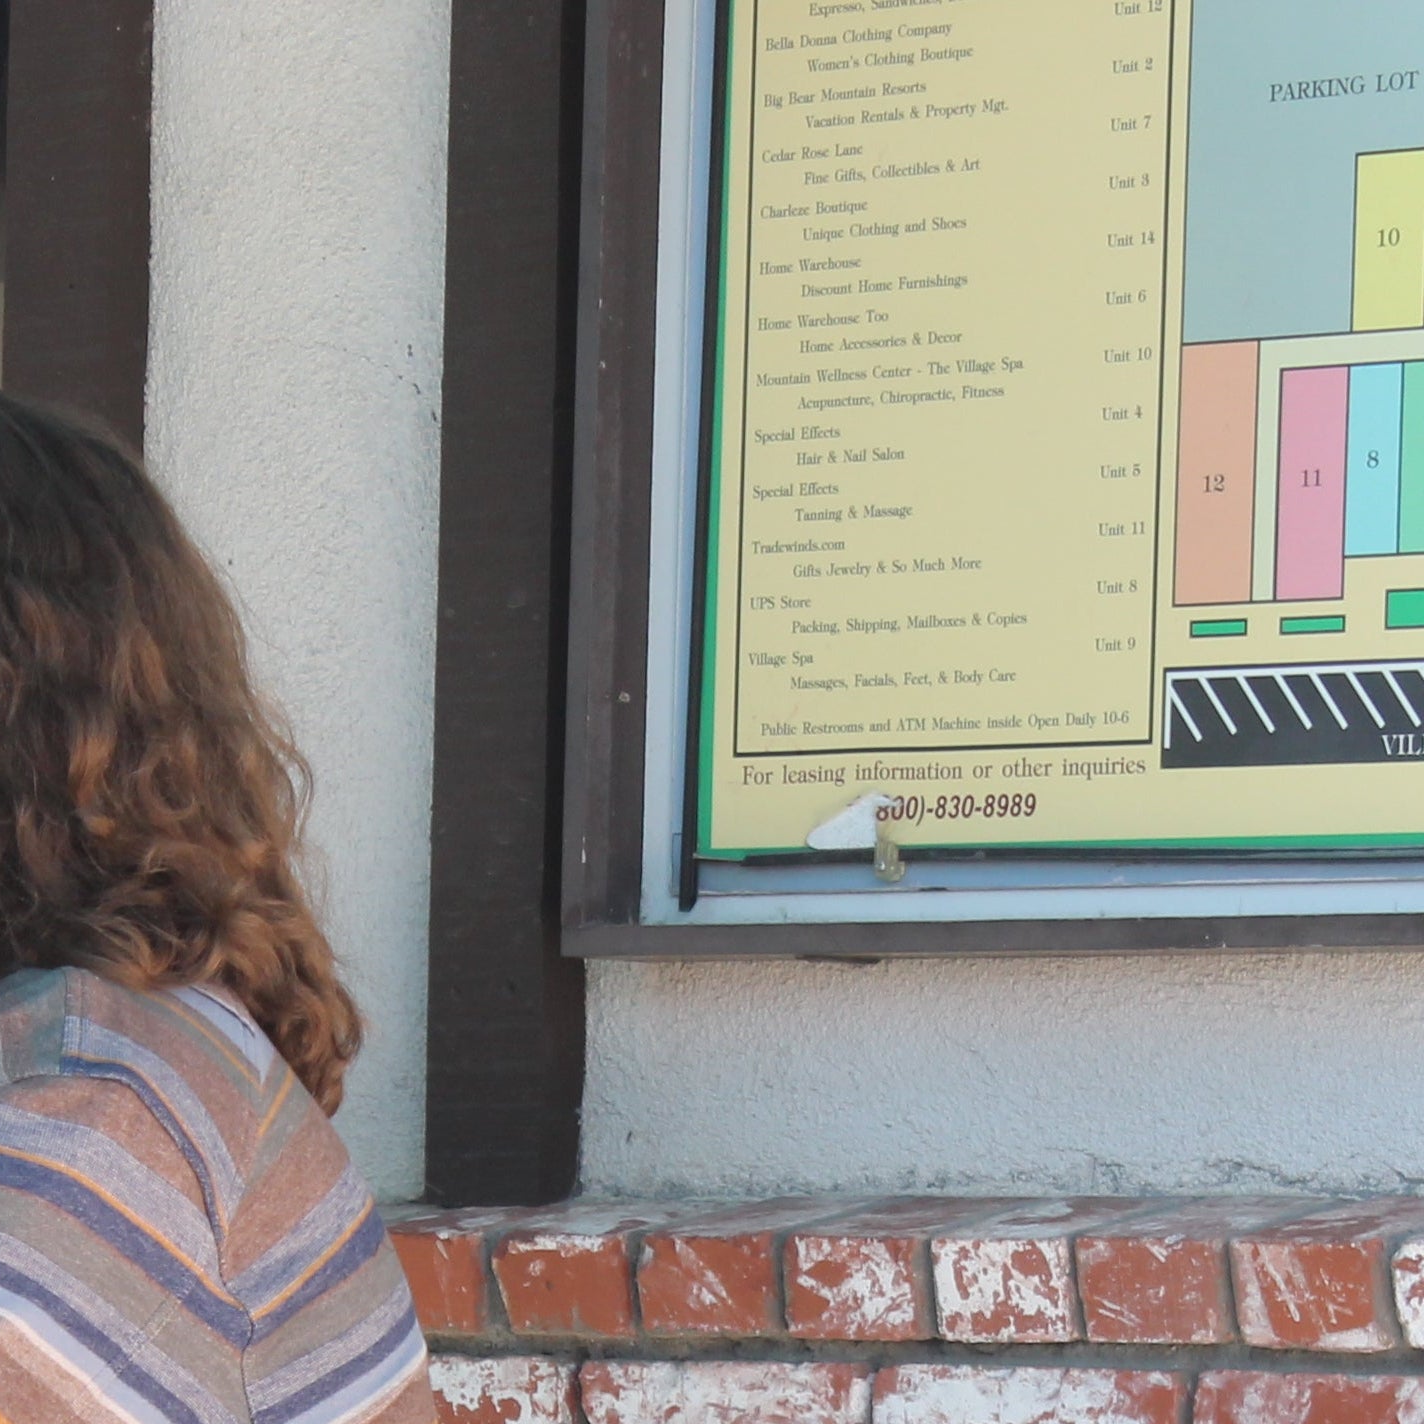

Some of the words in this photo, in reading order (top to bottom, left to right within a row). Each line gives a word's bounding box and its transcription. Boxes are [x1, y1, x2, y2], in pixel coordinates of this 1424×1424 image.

[809, 2, 866, 18] Expresso,
[1114, 1, 1141, 16] Unit
[1148, 0, 1163, 13] 12
[765, 36, 795, 52] Bella
[799, 34, 838, 48] Donna
[842, 28, 893, 43] Clothing
[897, 24, 952, 38] Company
[807, 55, 860, 72] Women's
[864, 51, 915, 66] Clothing
[920, 47, 974, 62] Boutique
[1112, 59, 1139, 74] Unit
[1144, 57, 1154, 71] 2
[1270, 76, 1366, 102] PARKING
[1376, 70, 1420, 93] LOT
[763, 93, 783, 110] Big
[788, 91, 816, 105] Bear
[820, 87, 876, 102] Mountain
[882, 82, 927, 96] Resorts
[805, 114, 856, 129] Vacation
[860, 107, 905, 124] Rentals
[909, 105, 920, 119] &
[925, 104, 977, 119] Property
[981, 98, 1009, 114] Mgt.
[1110, 117, 1137, 132] Unit
[1143, 114, 1152, 129] 7
[761, 148, 797, 164] Cedar
[801, 146, 830, 160] Rose
[834, 143, 863, 157] Lane
[804, 171, 830, 186] Fine
[834, 167, 867, 183] Gifts,
[871, 161, 941, 179] Collectibles
[945, 159, 956, 173] &
[960, 158, 980, 172] Art
[1109, 175, 1135, 190] Unit
[760, 204, 810, 219] Charleze
[815, 201, 868, 215] Boutique
[802, 227, 844, 243] Unique
[849, 222, 900, 237] Clothing
[904, 218, 926, 233] and
[931, 216, 967, 231] Shoes
[1107, 233, 1134, 247] Unit
[1141, 230, 1156, 245] 14
[1378, 227, 1401, 248] 10
[759, 261, 794, 276] Home
[798, 257, 862, 272] Warehouse
[801, 283, 853, 298] Discount
[858, 279, 893, 293] Home
[898, 274, 969, 290] Furnishings
[1105, 291, 1132, 305] Unit
[1137, 289, 1147, 303] 6
[757, 317, 793, 331] Home
[797, 313, 860, 328] Warehouse
[865, 309, 890, 323] Too
[799, 339, 834, 354] Home
[838, 336, 907, 351] Accessories
[911, 332, 922, 346] &
[927, 331, 963, 345] Decor
[1103, 349, 1131, 363] Unit
[1138, 346, 1153, 361] 10
[756, 372, 811, 387] Mountain
[816, 368, 868, 383] Wellness
[872, 365, 913, 379] Center
[926, 361, 951, 376] The
[955, 359, 996, 375] Village
[1001, 356, 1024, 373] Spa
[797, 396, 875, 411] Acupuncture,
[879, 389, 956, 405] Chiropractic,
[961, 385, 1005, 399] Fitness
[1102, 407, 1128, 421] Unit
[1134, 405, 1143, 419] 4
[754, 427, 795, 446] Special
[800, 425, 841, 440] Effects
[796, 452, 823, 466] Hair
[827, 450, 837, 464] &
[843, 448, 867, 463] Nail
[872, 447, 905, 462] Salon
[1366, 450, 1380, 469] 8
[1100, 465, 1127, 479] Unit
[1132, 463, 1141, 477] 5
[1302, 469, 1321, 488] 11
[752, 483, 794, 502] Special
[799, 482, 840, 497] Effects
[1204, 474, 1225, 493] 12
[794, 508, 843, 523] Tanning
[847, 505, 858, 519] &
[863, 504, 913, 519] Massage
[1098, 522, 1125, 537] Unit
[1132, 521, 1145, 535] 11
[751, 539, 845, 554] Tradewinds.com
[792, 563, 822, 578] Gifts
[825, 562, 872, 578] Jewelry
[876, 560, 887, 574] &
[891, 559, 908, 574] So
[912, 557, 946, 572] Much
[951, 556, 982, 570] More
[1096, 580, 1123, 594] Unit
[1128, 579, 1138, 593] 8
[749, 596, 776, 610] UPS
[780, 595, 812, 609] Store
[791, 620, 841, 635] Packing,
[846, 618, 901, 634] Shipping,
[906, 614, 967, 629] Mailboxes
[971, 612, 982, 626] &
[986, 612, 1028, 628] Copies
[1095, 638, 1122, 652] Unit
[1127, 637, 1137, 650] 9
[748, 652, 787, 668] Village
[791, 651, 814, 667] Spa
[790, 676, 849, 691] Massages,
[854, 673, 898, 688] Facials,
[903, 671, 933, 687] Feet,
[937, 670, 948, 684] &
[953, 669, 984, 686] Body
[988, 668, 1017, 682] Care
[761, 722, 798, 737] Public
[802, 721, 865, 735] Restrooms
[868, 718, 891, 732] and
[895, 717, 926, 732] ATM
[931, 716, 981, 731] Machine
[987, 714, 1023, 729] inside
[1027, 714, 1060, 730] Open
[1065, 712, 1096, 729] Daily
[1103, 710, 1130, 725] 10-6
[1381, 733, 1424, 756] VIL
[742, 765, 774, 786] For
[782, 764, 846, 787] leasing
[855, 762, 963, 781] information
[972, 765, 994, 779] or
[1001, 758, 1053, 778] other
[1062, 757, 1146, 781] inquiries
[874, 792, 1037, 827] 800)-830-8989
